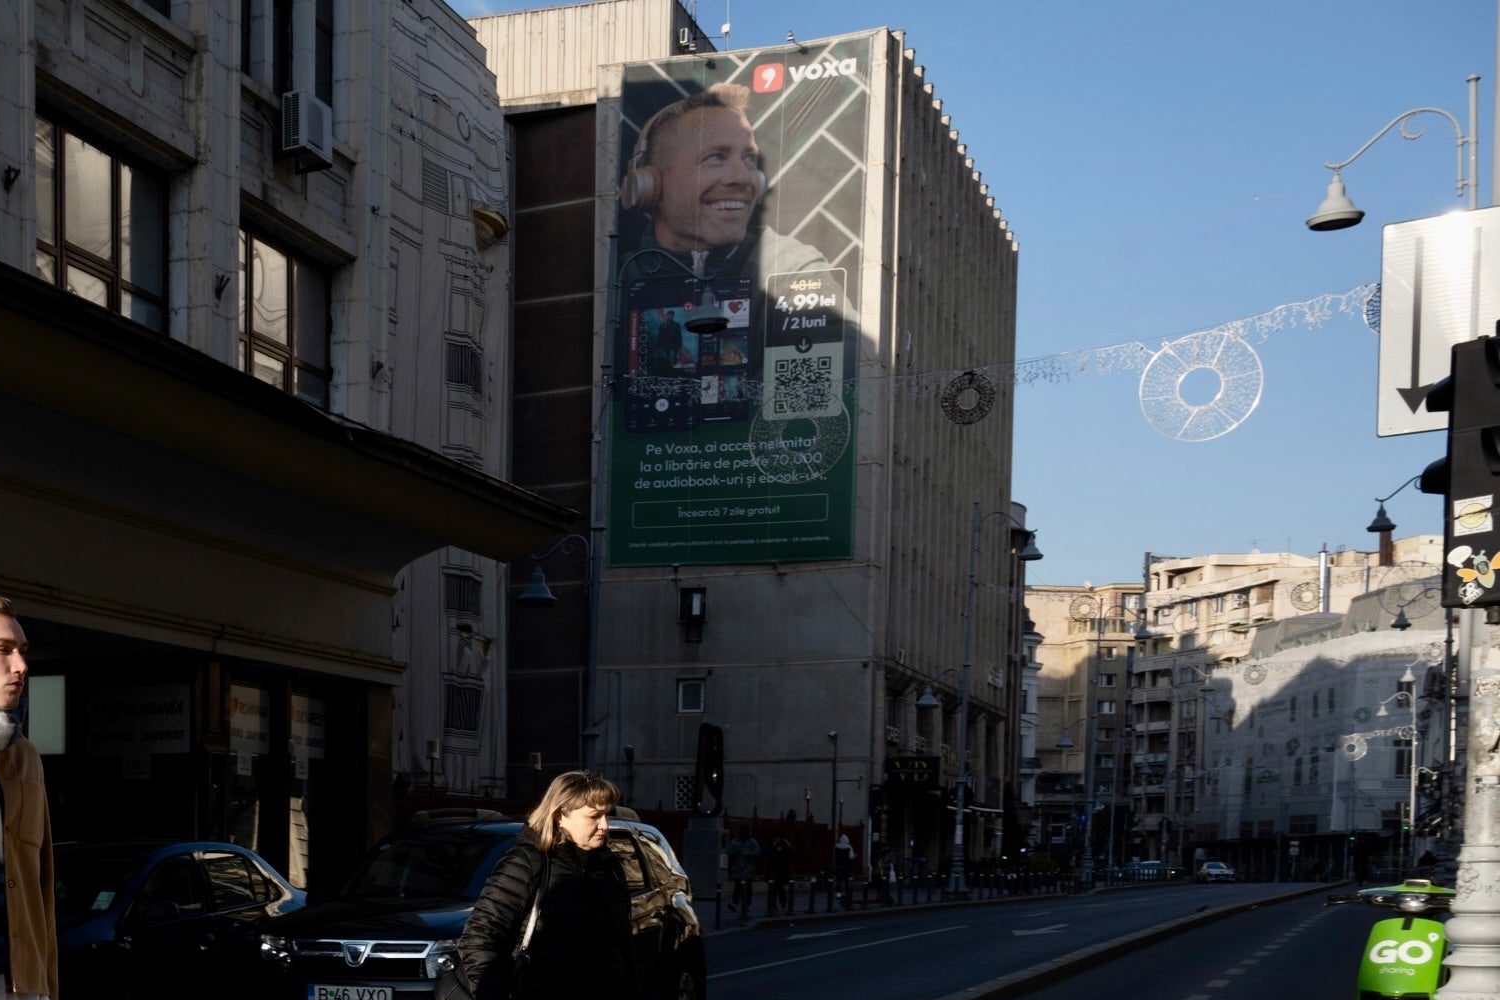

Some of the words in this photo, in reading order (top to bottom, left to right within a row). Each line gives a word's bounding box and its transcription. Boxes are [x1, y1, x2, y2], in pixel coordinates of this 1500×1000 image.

[788, 57, 857, 82] voxa
[790, 280, 806, 291] 48
[808, 279, 822, 290] lei
[774, 293, 819, 314] 4,99
[820, 294, 836, 307] lei
[782, 317, 790, 331] /
[791, 317, 800, 329] 2
[801, 315, 827, 328] luni
[646, 444, 663, 456] Pe
[665, 442, 702, 456] Voxa,
[705, 440, 717, 452] ai
[719, 440, 757, 452] acces
[759, 436, 818, 450] nelimitat
[640, 461, 652, 473] la
[654, 463, 663, 472] o
[665, 457, 711, 472] librărie
[714, 456, 731, 469] de
[733, 456, 769, 473] peste
[634, 477, 651, 490] de
[653, 474, 744, 489] audiobook-uri
[746, 472, 757, 488] și
[677, 506, 721, 519] Încearcă
[722, 506, 728, 517] 7
[729, 506, 746, 517] zile
[747, 505, 781, 519] gratuit
[1369, 940, 1434, 965] GO
[1379, 966, 1416, 976] sharing
